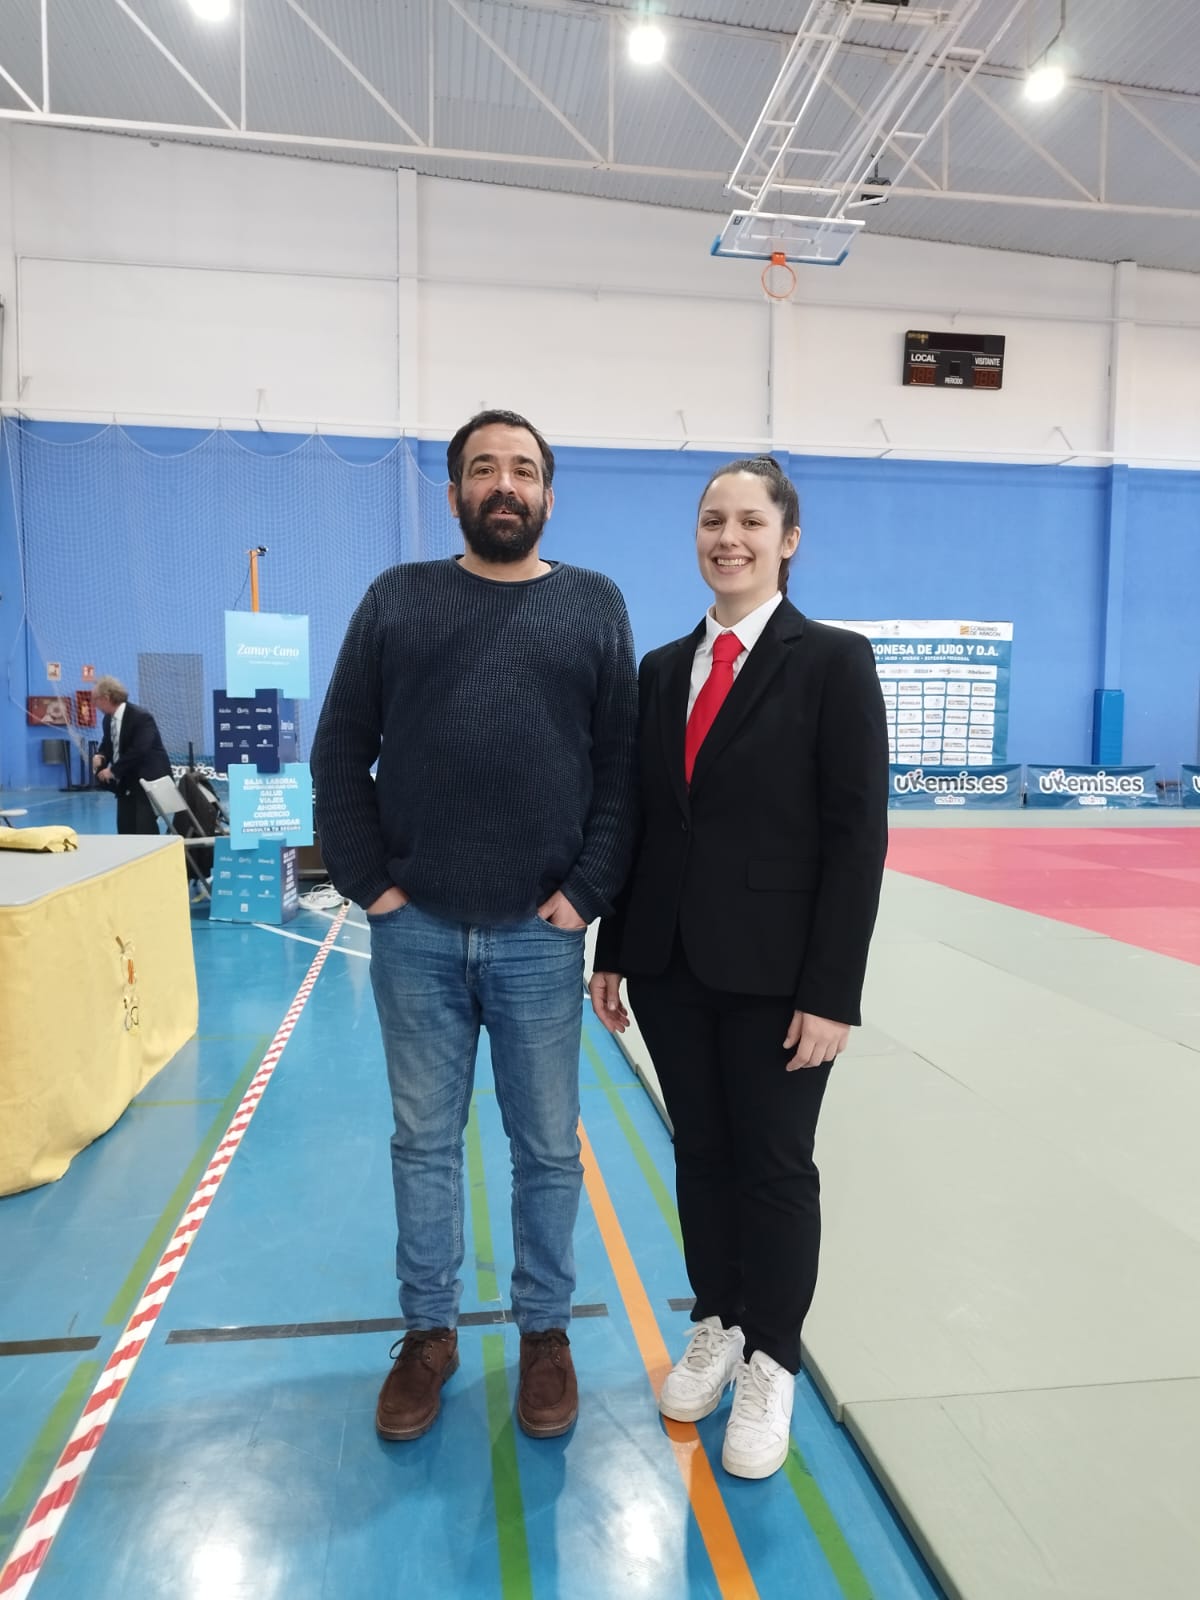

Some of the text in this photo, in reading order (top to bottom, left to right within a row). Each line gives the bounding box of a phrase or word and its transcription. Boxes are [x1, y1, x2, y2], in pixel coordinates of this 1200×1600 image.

[911, 353, 937, 362] LOCAL
[975, 357, 1000, 366] VISITANTE
[917, 644, 933, 655] DE
[934, 644, 964, 655] JUDO
[966, 645, 975, 655] Y
[976, 645, 999, 656] D.A.
[895, 769, 1007, 793] ukemis.es
[1039, 769, 1143, 793] ukemis.es
